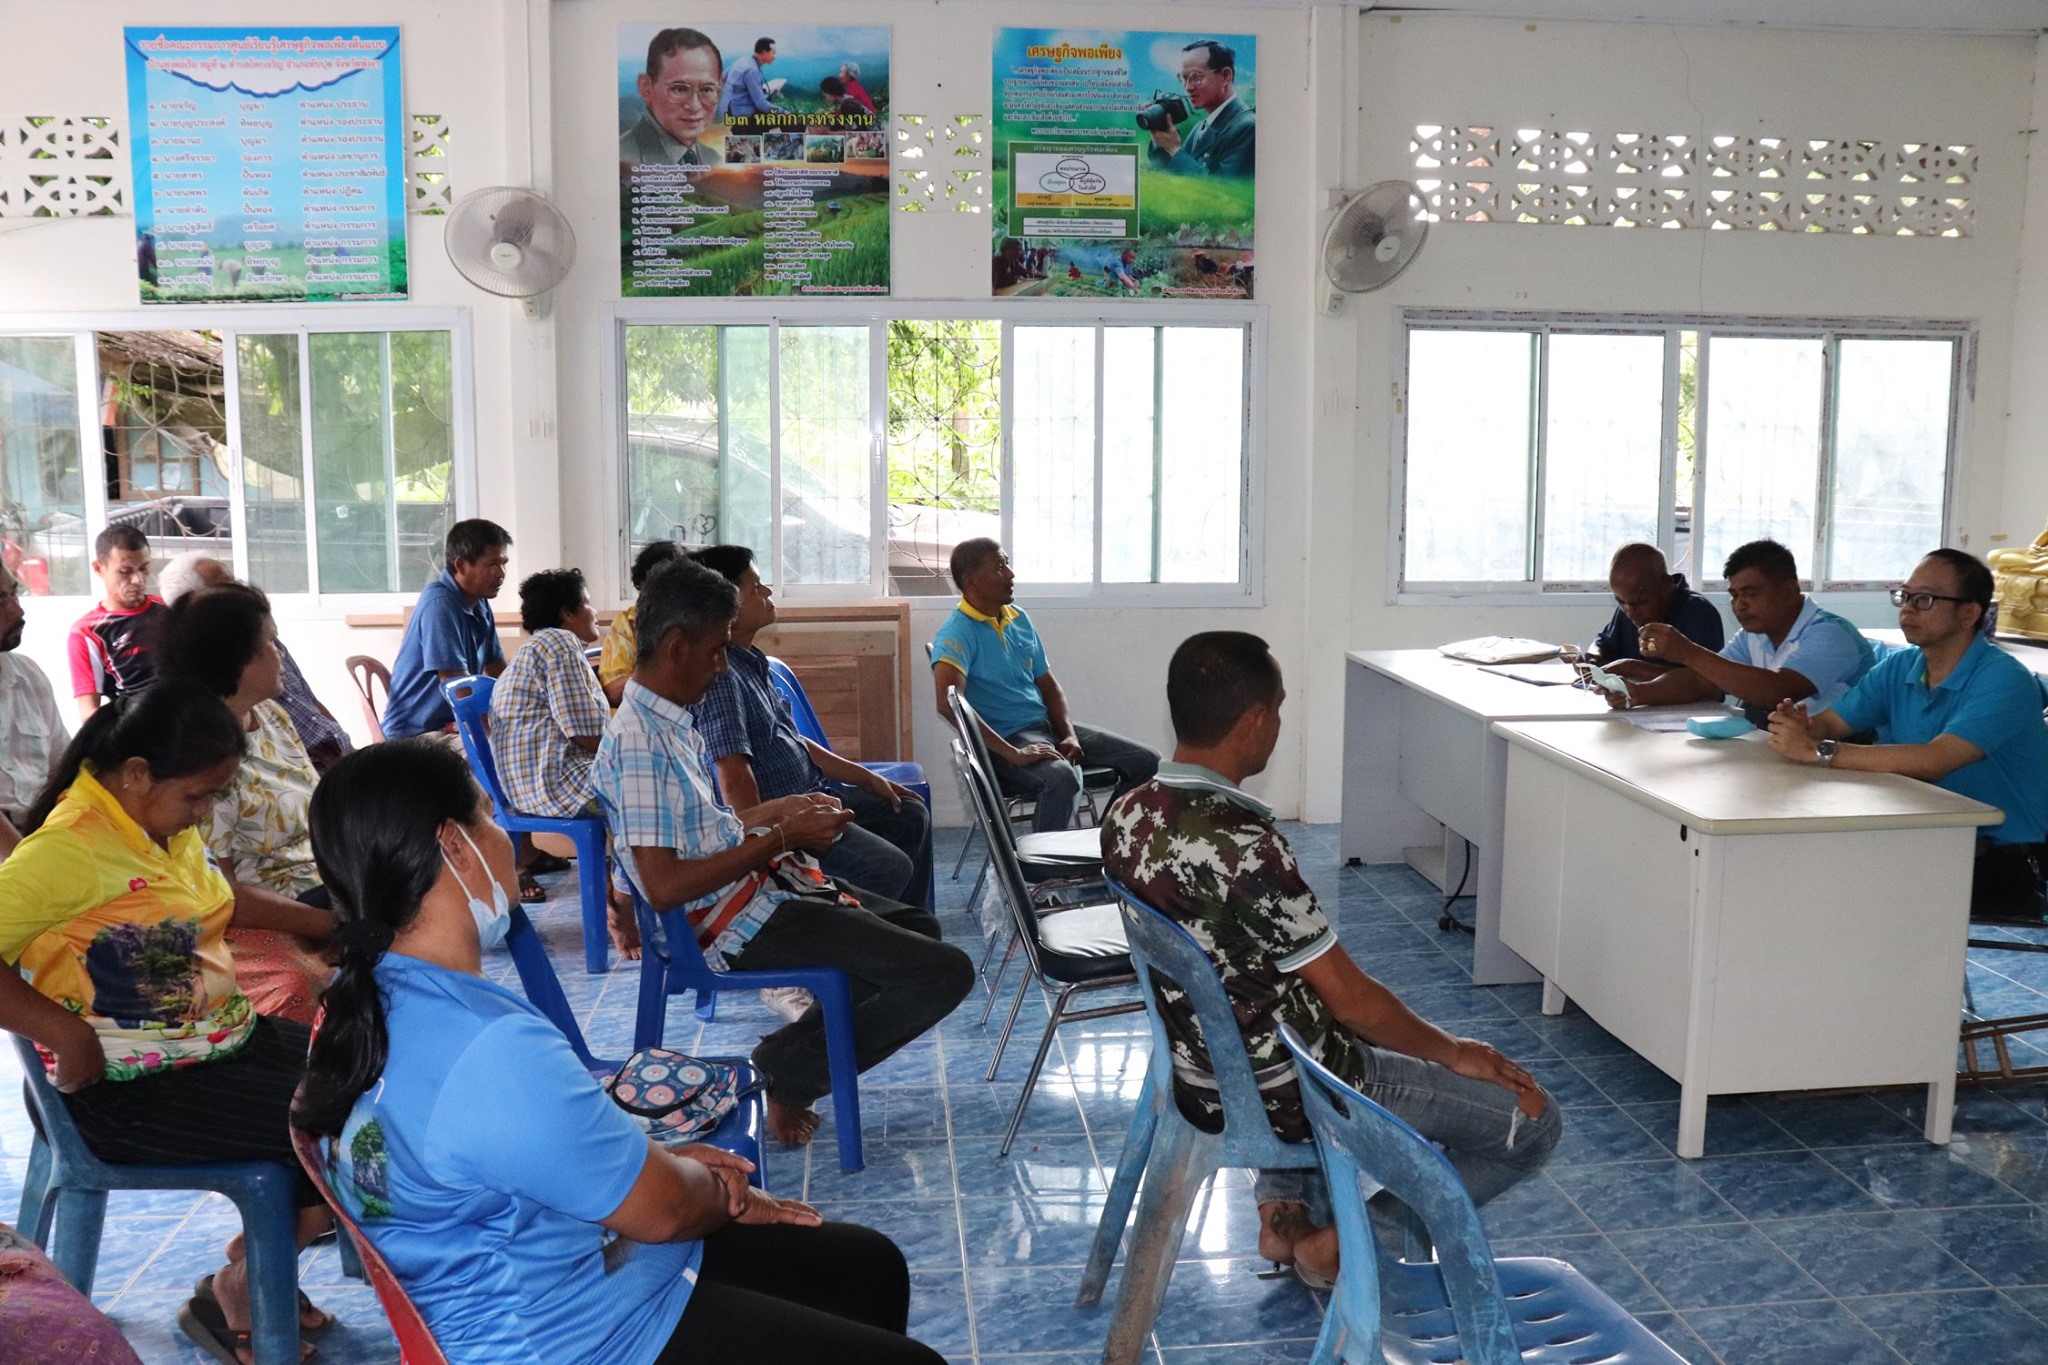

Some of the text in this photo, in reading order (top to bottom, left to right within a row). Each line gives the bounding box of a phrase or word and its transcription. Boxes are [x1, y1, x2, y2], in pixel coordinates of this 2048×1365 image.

[1026, 44, 1122, 63] เศรษฐกิจพอเพียง
[724, 109, 873, 126] ๒๓ หลักการทรงงาน
[340, 204, 374, 212] กรรมการ
